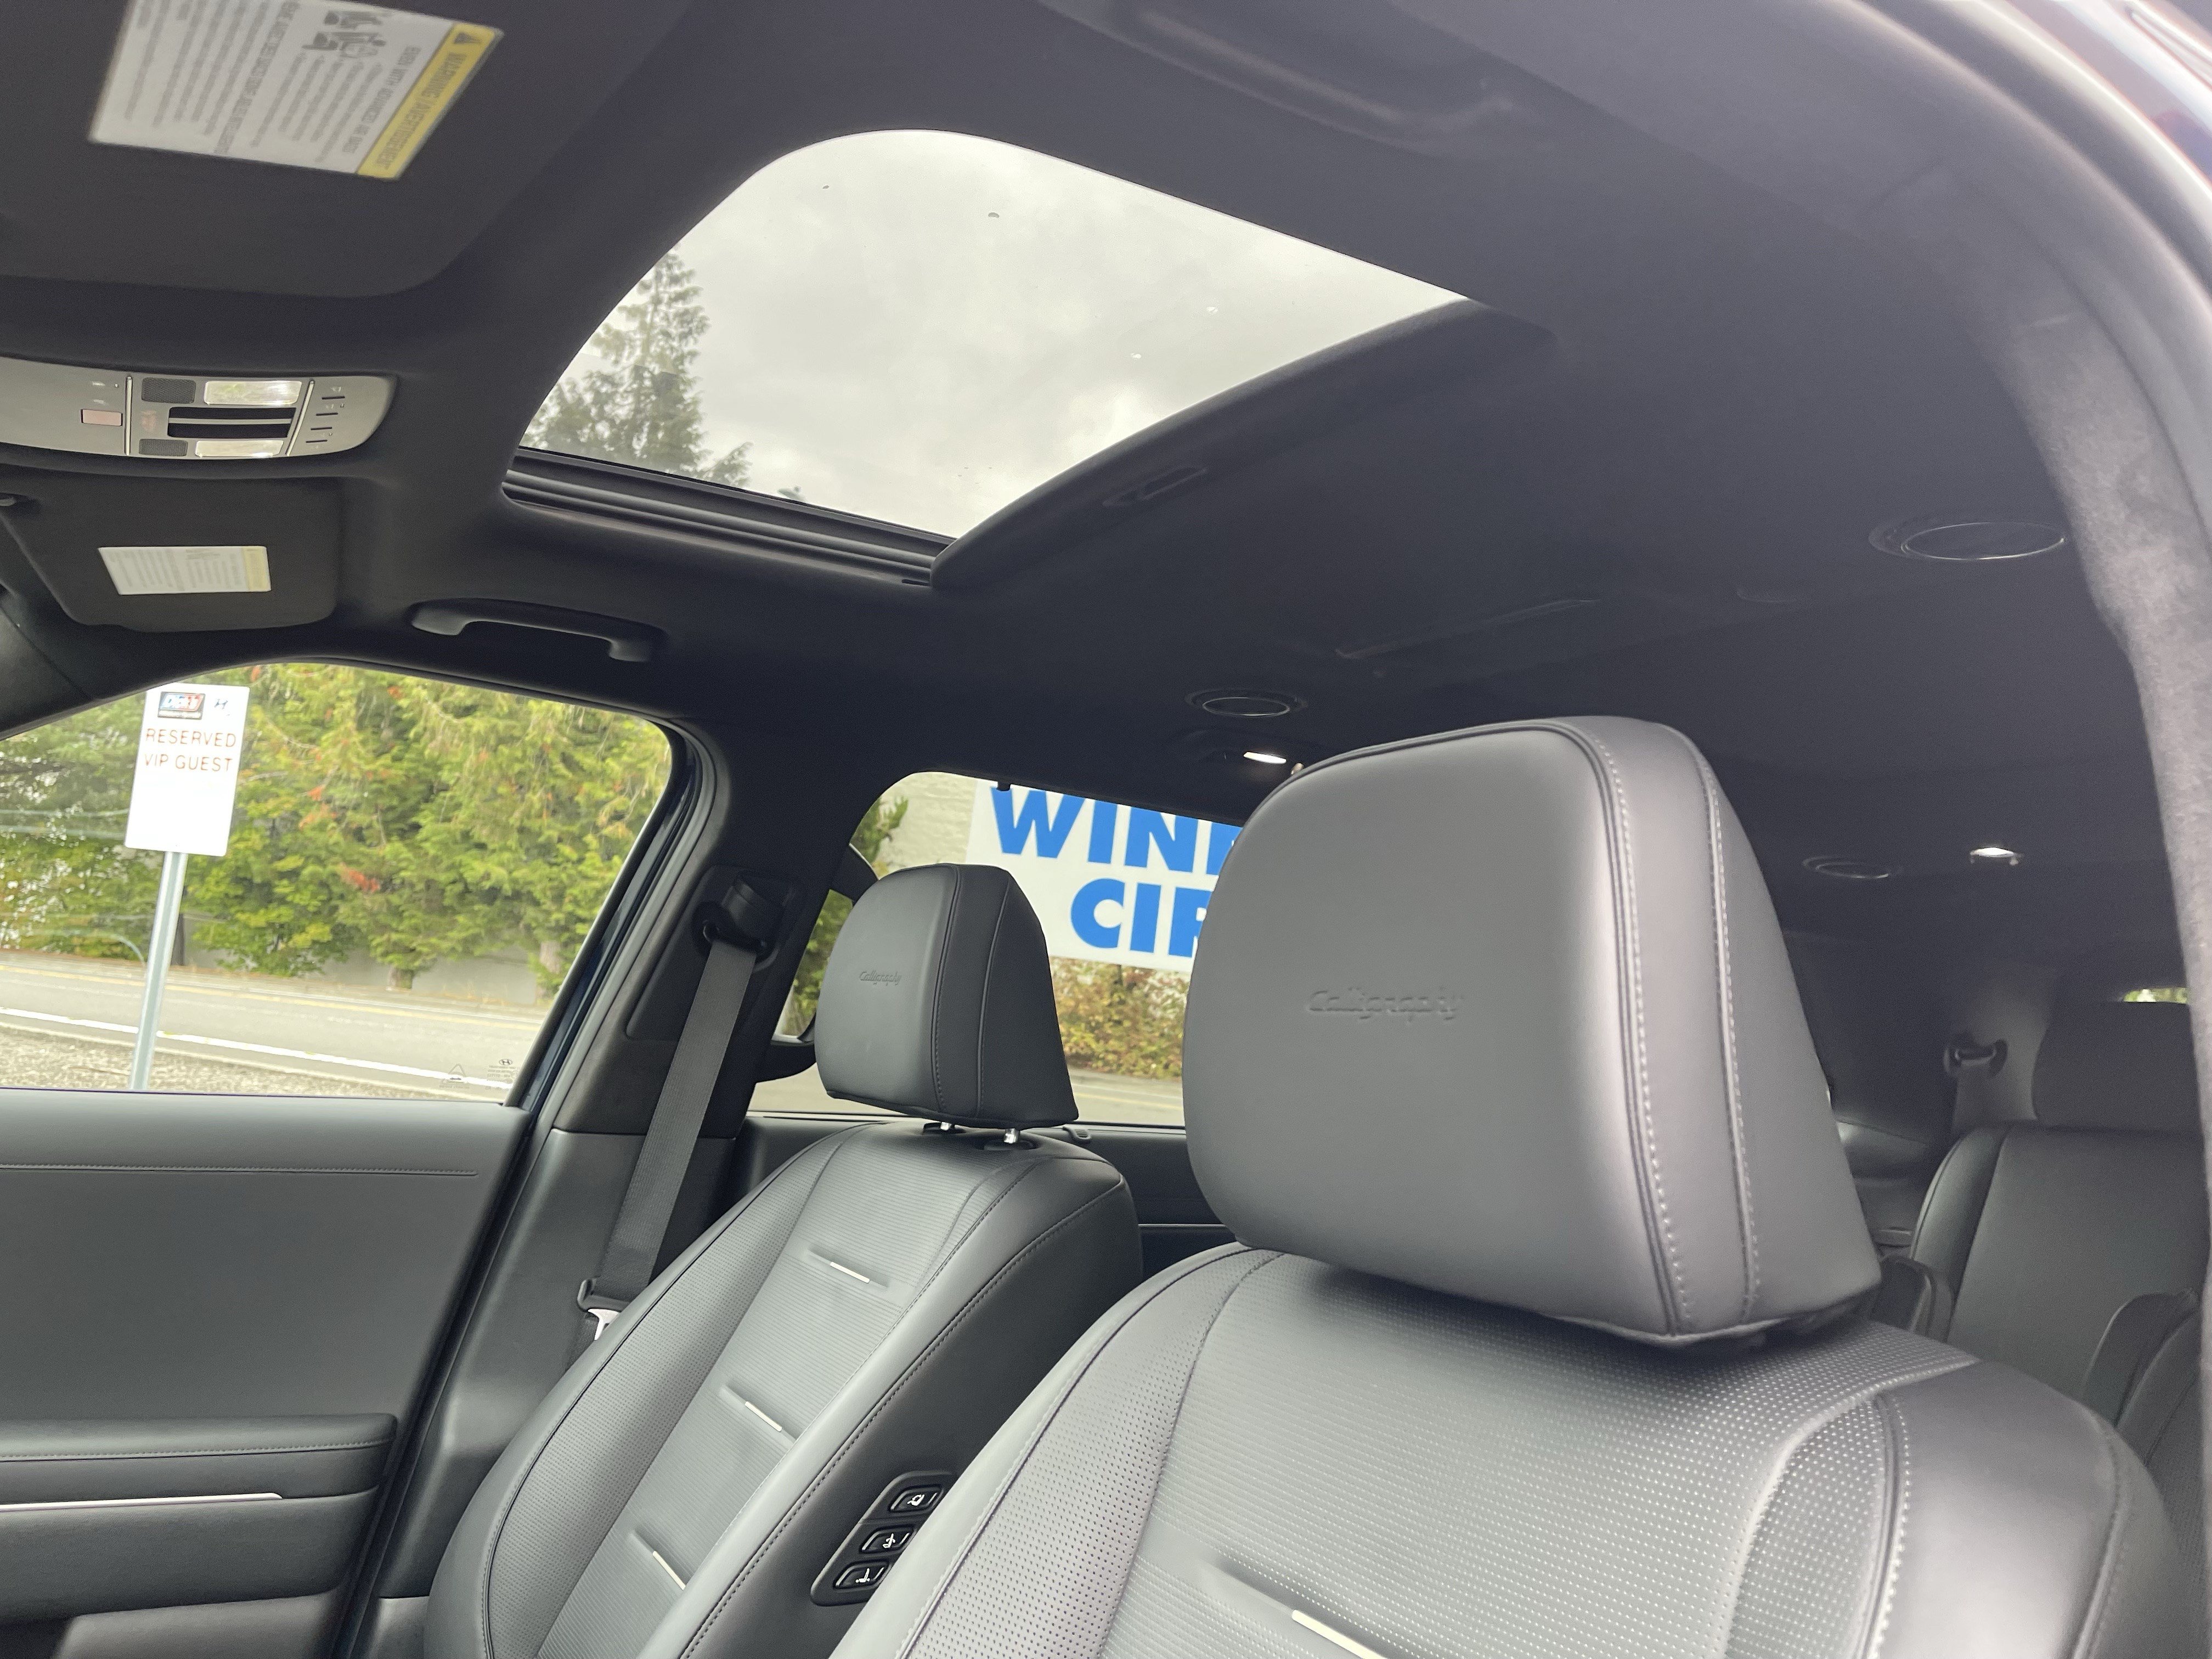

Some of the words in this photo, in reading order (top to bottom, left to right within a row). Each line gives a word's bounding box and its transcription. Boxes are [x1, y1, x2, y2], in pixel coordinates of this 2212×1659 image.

[146, 729, 236, 747] RESERVED
[145, 754, 168, 767] VIP
[176, 755, 233, 771] GUEST
[859, 970, 902, 986] Calligraphy
